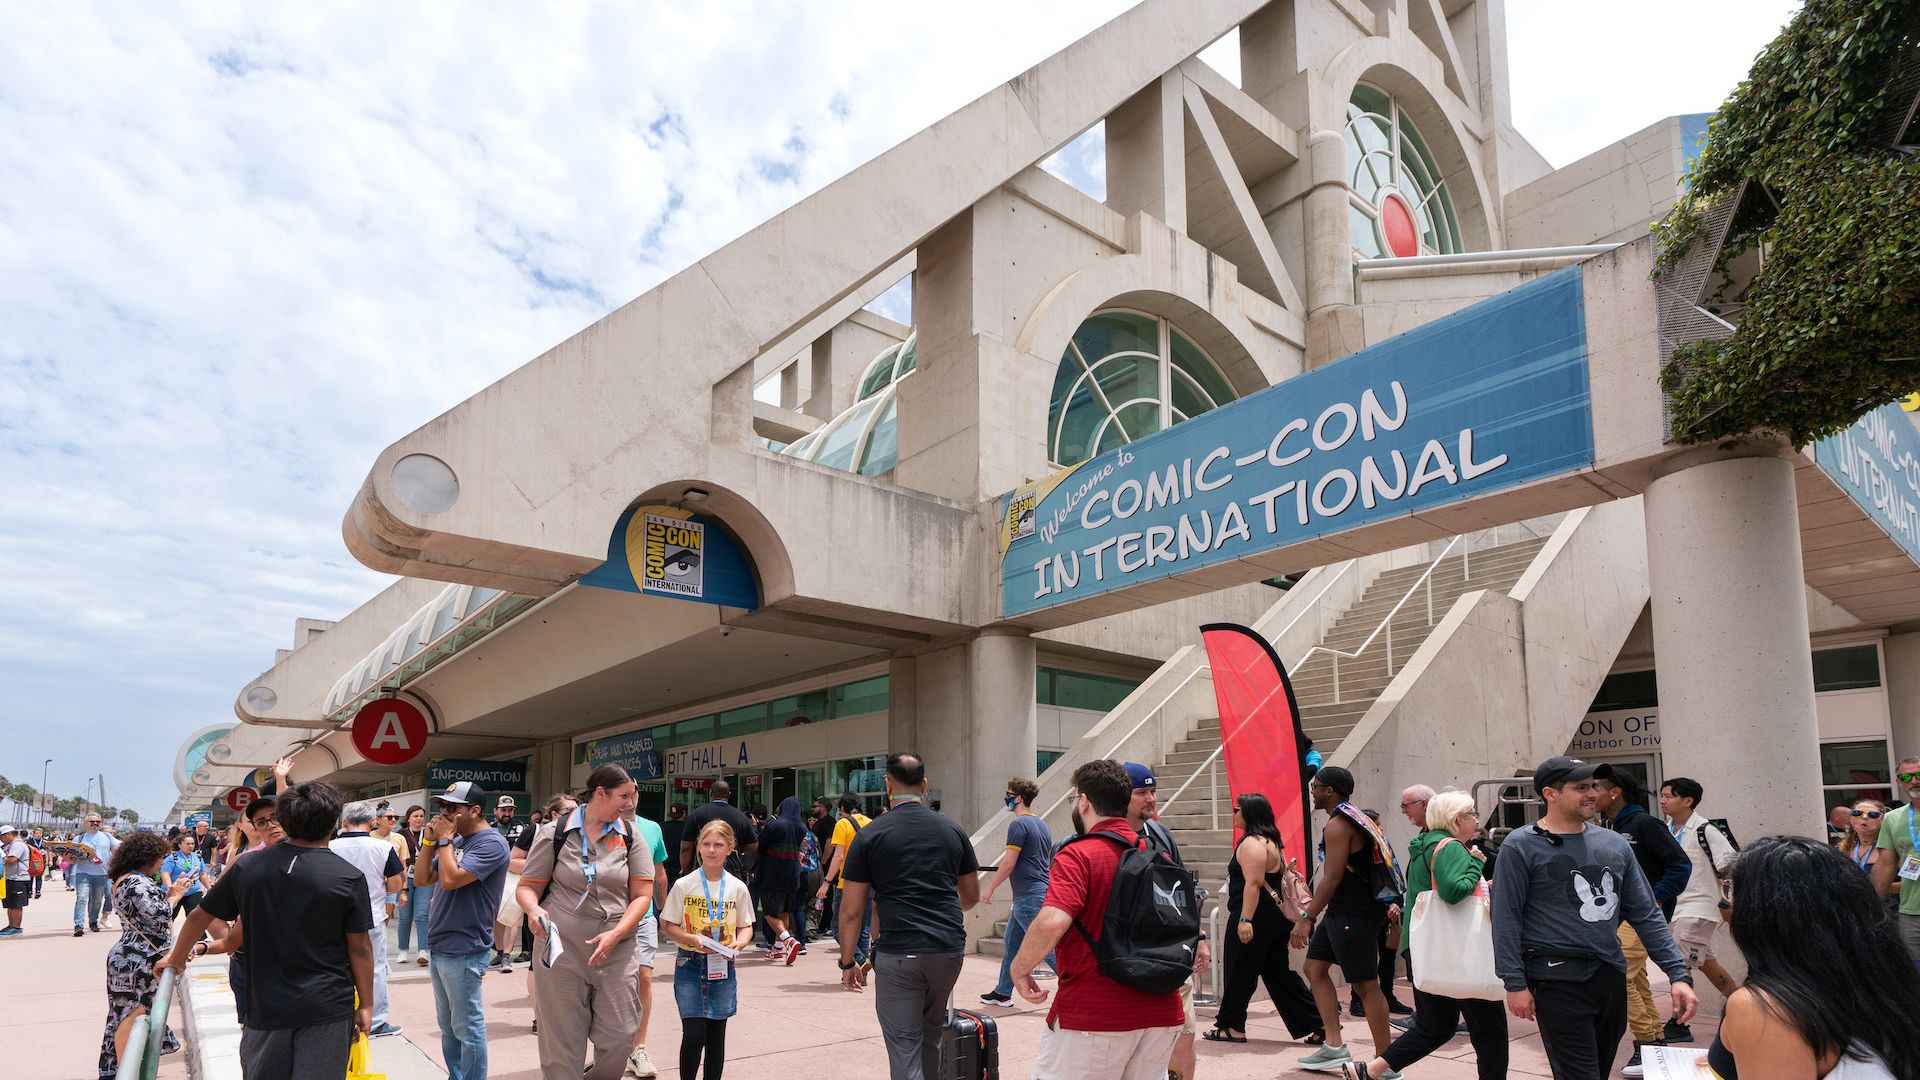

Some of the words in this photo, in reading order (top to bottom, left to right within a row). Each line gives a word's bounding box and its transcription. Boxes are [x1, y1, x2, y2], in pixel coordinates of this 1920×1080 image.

[1080, 381, 1408, 530] COMIC-CON
[1019, 496, 1034, 511] CON
[1040, 464, 1113, 544] Welcome
[1117, 449, 1135, 467] to
[646, 515, 665, 524] SAN
[1011, 502, 1019, 535] COMIC
[1034, 428, 1508, 599] INTERNATIONAL
[666, 527, 701, 550] CON
[646, 523, 666, 580] COMIC
[644, 579, 701, 594] INTERNATIONAL
[370, 712, 411, 750] A
[1575, 720, 1613, 736] ON
[593, 746, 608, 760] DEAF
[611, 744, 623, 757] AND
[624, 737, 653, 754] DISABLED
[1572, 738, 1624, 750] Harbor
[691, 746, 727, 771] HALL
[737, 741, 749, 765] A
[431, 767, 521, 783] INFORMATION
[681, 779, 705, 788] EXIT
[746, 776, 759, 786] EXIT
[236, 791, 252, 807] B
